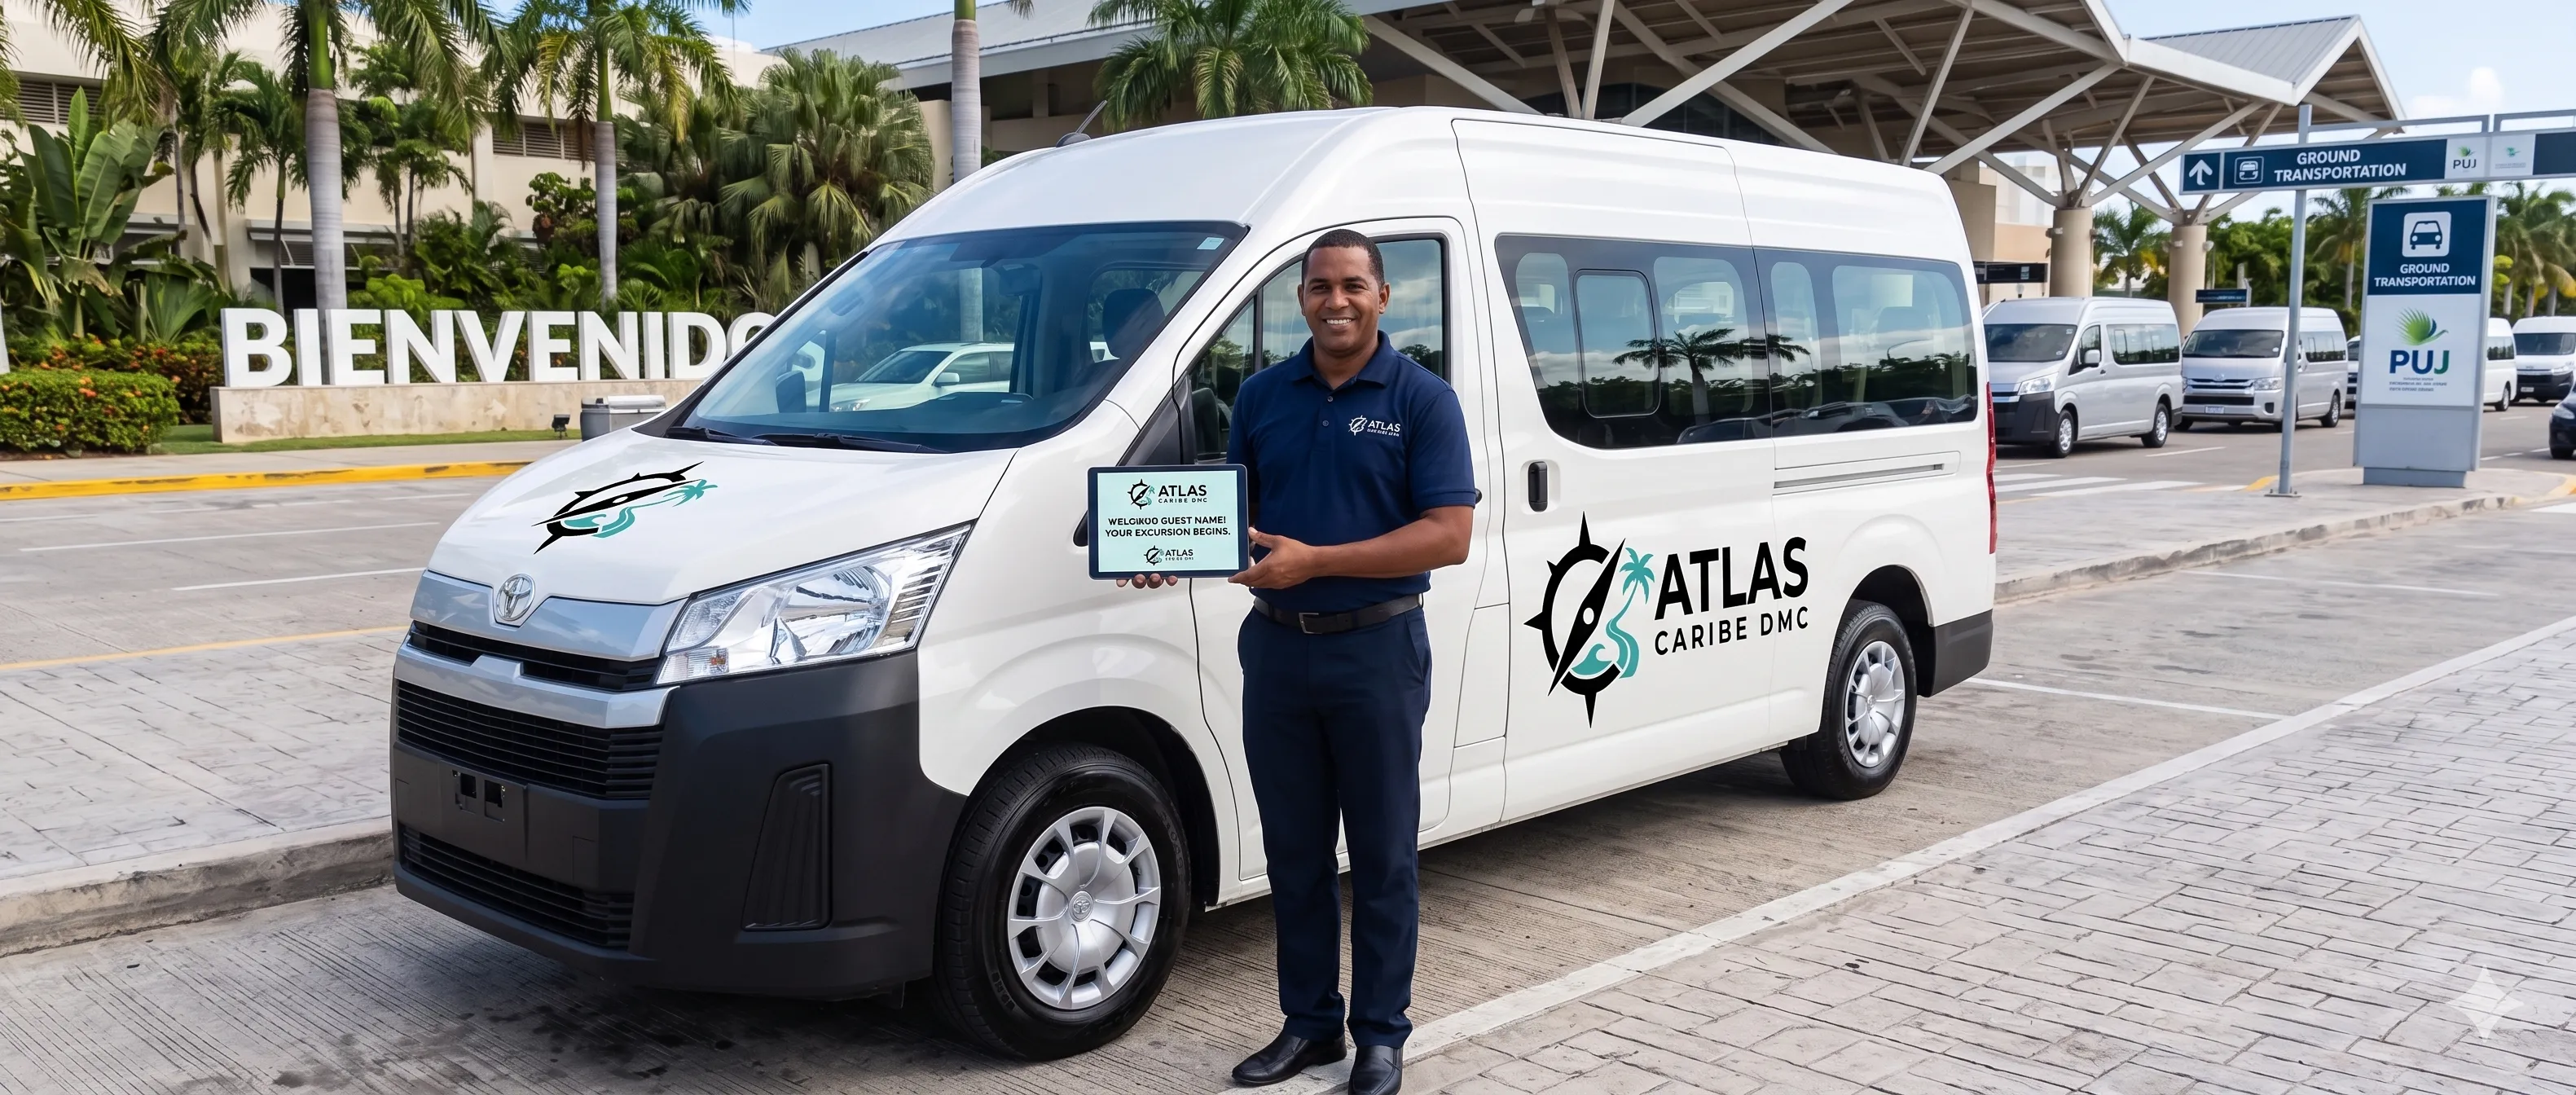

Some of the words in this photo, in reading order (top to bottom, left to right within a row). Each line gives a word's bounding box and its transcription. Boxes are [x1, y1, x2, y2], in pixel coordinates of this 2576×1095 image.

[2297, 149, 2361, 165] GROUND
[2453, 159, 2477, 169] PUJ
[2274, 163, 2407, 182] TRANSPORTATION
[2400, 263, 2450, 275] GROUND
[2374, 275, 2476, 287] TRANSPORTATION
[2389, 350, 2450, 375] PUJ
[1368, 420, 1401, 433] ATLAS
[1158, 484, 1207, 497] ATLAS
[1161, 517, 1193, 526] GUEST
[1194, 516, 1226, 525] NAME!
[1105, 529, 1132, 538] YOUR
[1135, 528, 1191, 537] EXCURSION
[1193, 527, 1231, 536] BEGINS.
[1165, 548, 1193, 556] ATLAS
[1654, 536, 1809, 621] ATLAS
[1654, 616, 1748, 656] CARIBE
[1760, 606, 1809, 636] DMC
